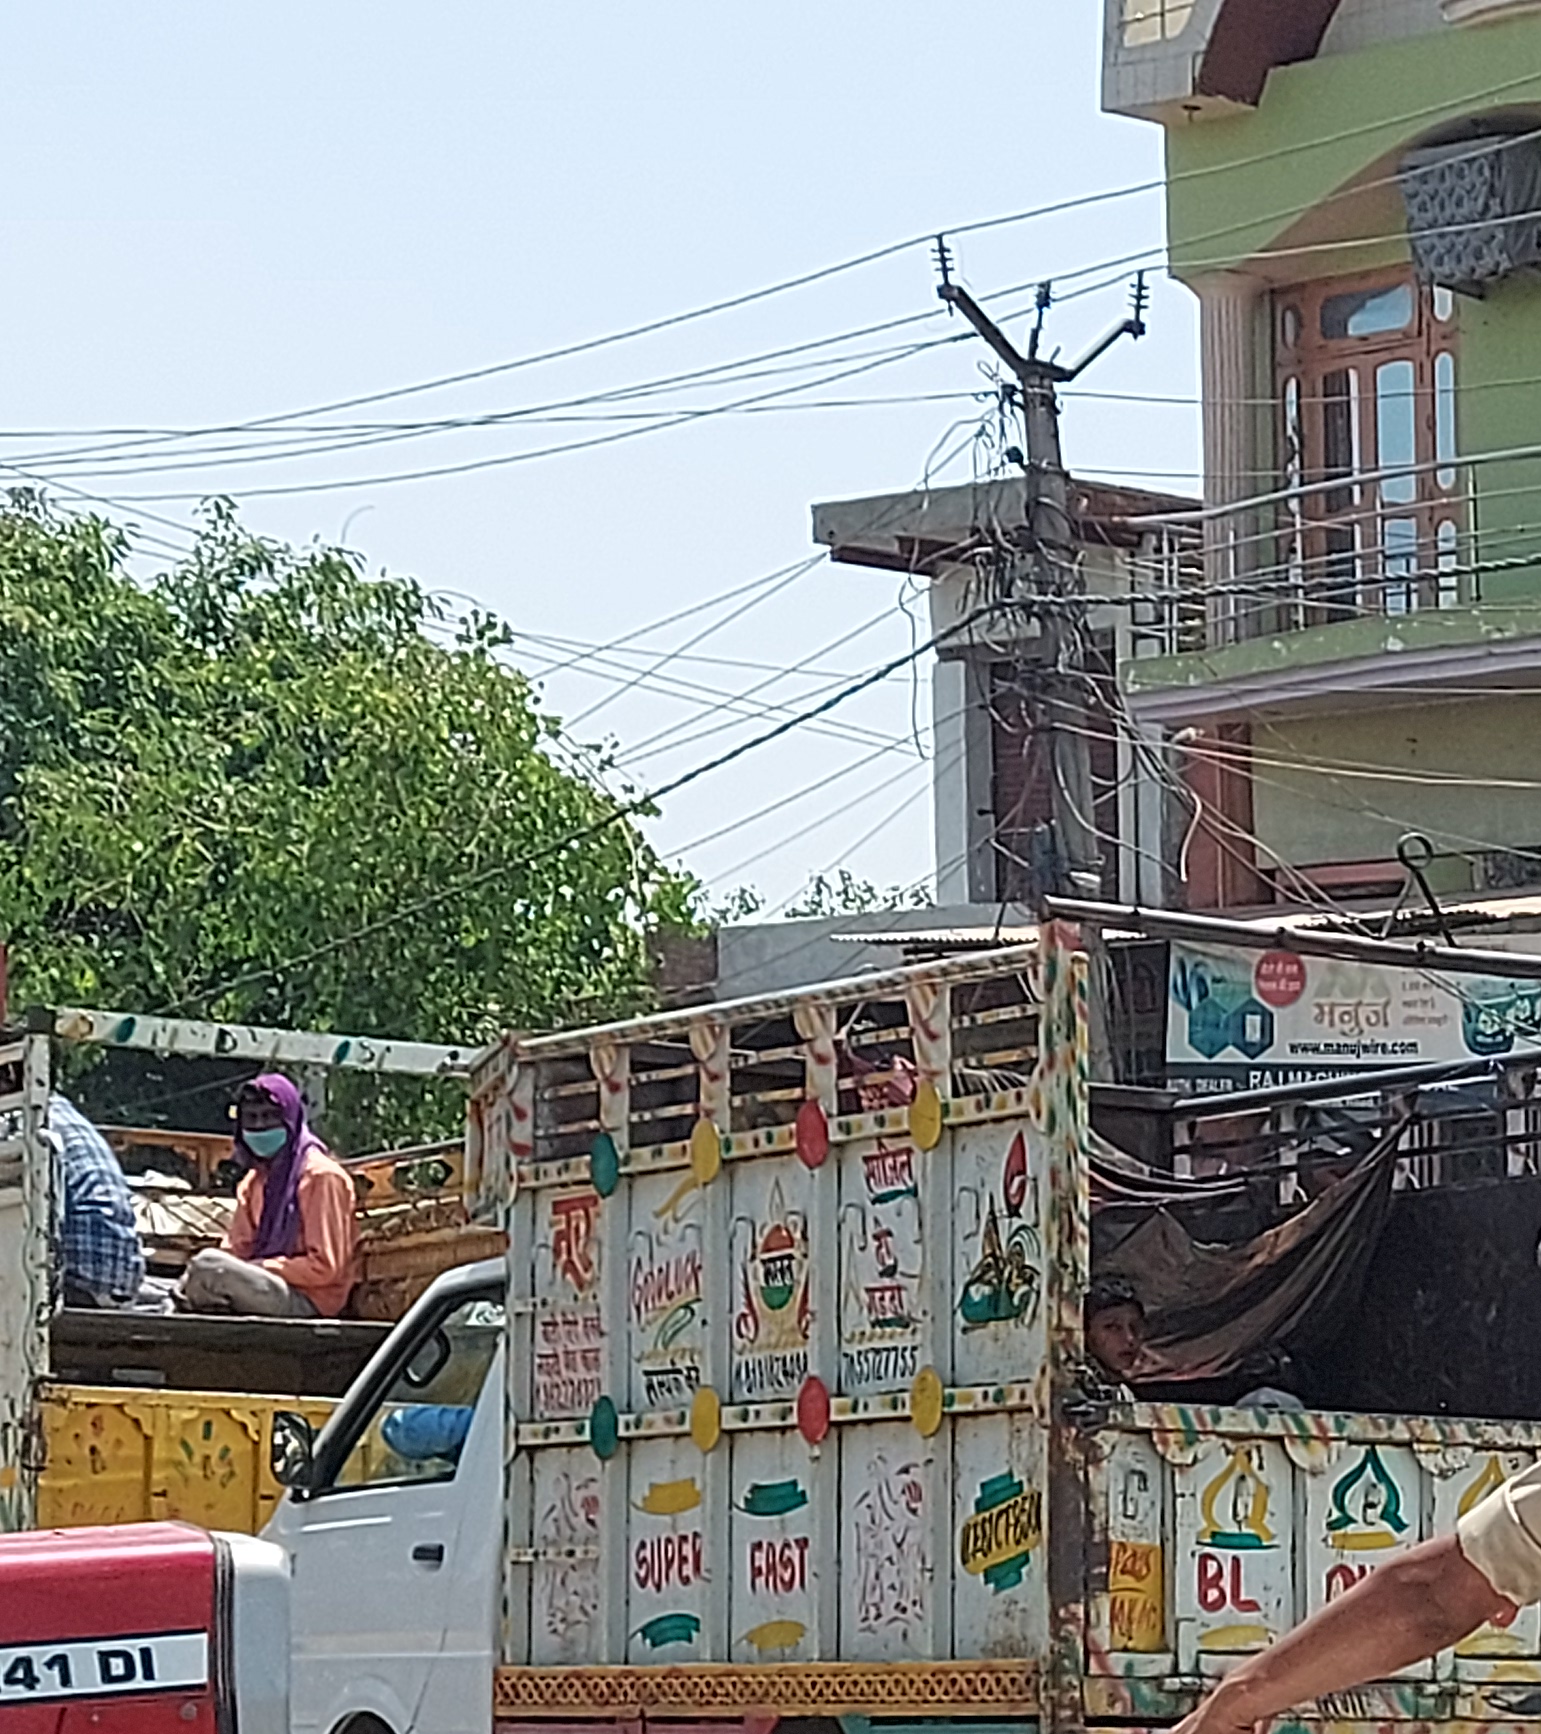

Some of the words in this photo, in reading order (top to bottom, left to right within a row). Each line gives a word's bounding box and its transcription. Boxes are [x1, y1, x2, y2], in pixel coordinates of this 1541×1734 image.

[1312, 1000, 1392, 1037] मनुज
[634, 1530, 702, 1593] SUPER
[749, 1536, 810, 1596] FAST
[1197, 1552, 1262, 1613] BL
[99, 1645, 156, 1685] DI
